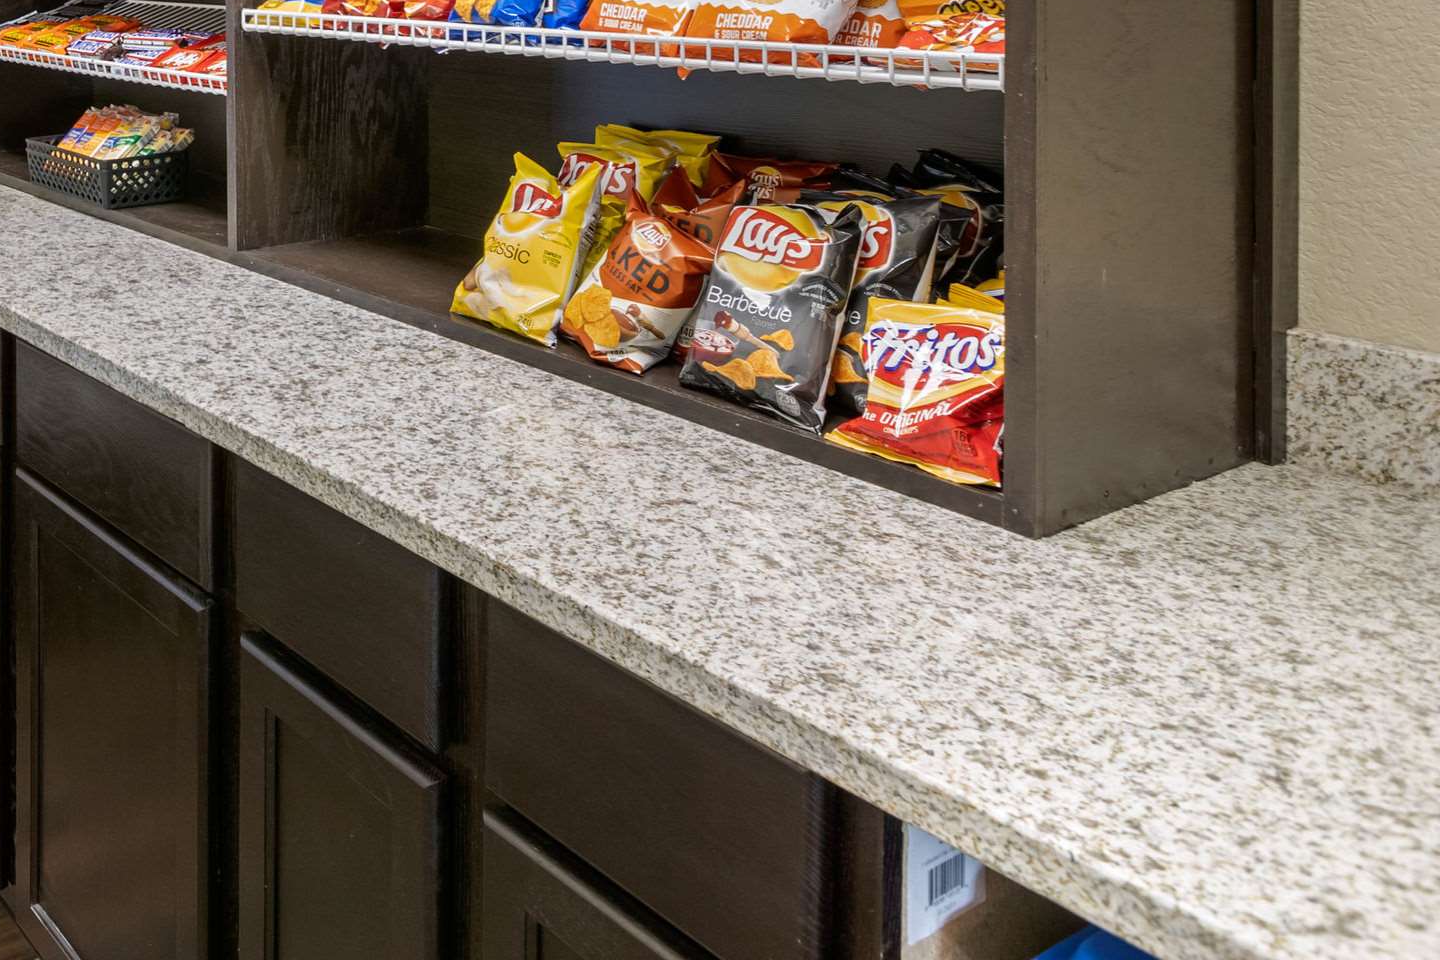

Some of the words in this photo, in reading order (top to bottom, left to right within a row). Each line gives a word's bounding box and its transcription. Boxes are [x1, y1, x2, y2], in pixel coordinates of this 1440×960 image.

[600, 2, 647, 22] CHEDDAR
[715, 13, 773, 30] CHEDDAR
[620, 21, 643, 33] CREAM
[721, 30, 739, 40] SOUR
[741, 31, 768, 41] CREAM
[843, 18, 882, 39] DDAR
[844, 34, 879, 48] CREAM
[720, 207, 812, 265] Lay's
[611, 245, 670, 294] KED
[706, 286, 792, 323] Barbecue
[862, 321, 1002, 373] Fritos
[863, 407, 877, 422] he
